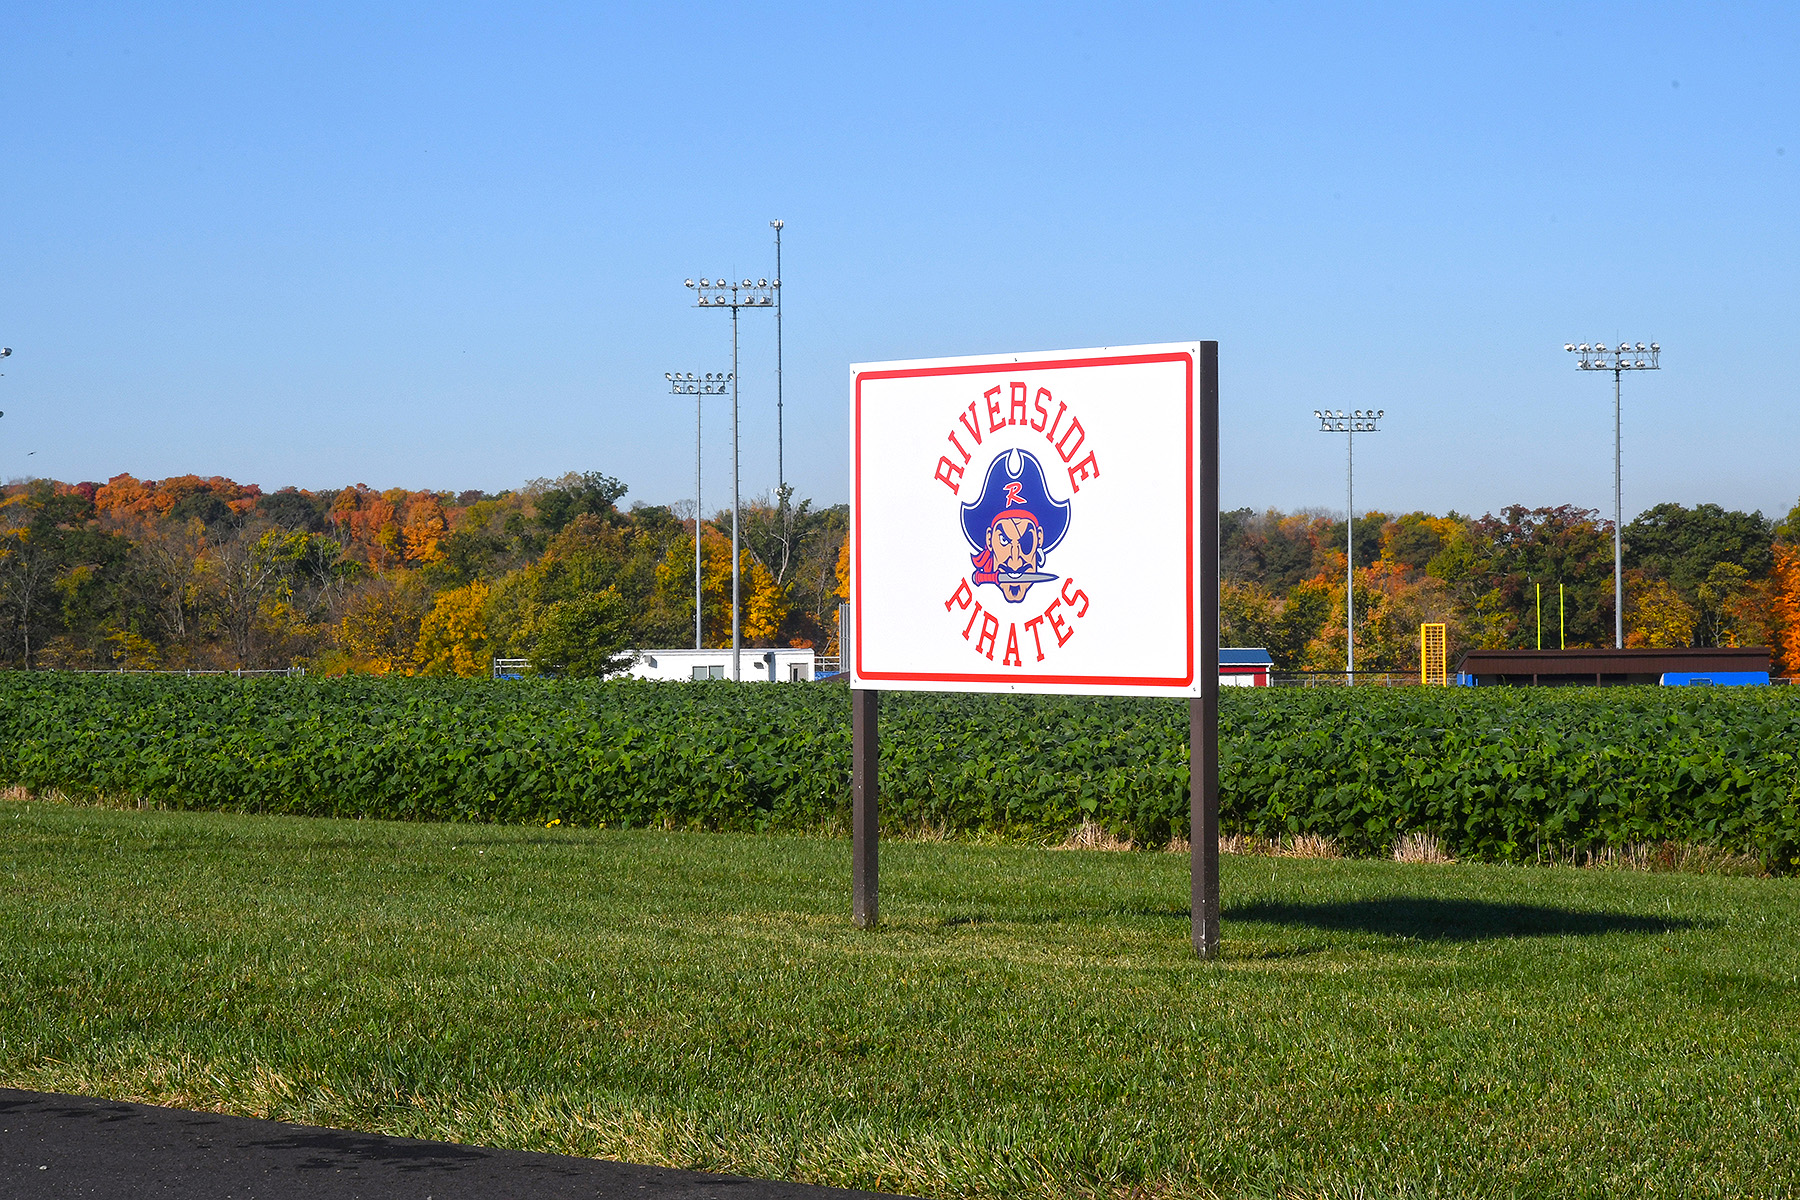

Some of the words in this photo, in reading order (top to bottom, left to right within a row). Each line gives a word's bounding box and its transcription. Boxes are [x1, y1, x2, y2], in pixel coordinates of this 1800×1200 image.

[934, 381, 1100, 496] RIVERSIDE
[1003, 481, 1027, 507] R
[945, 577, 1090, 667] PIRATES
